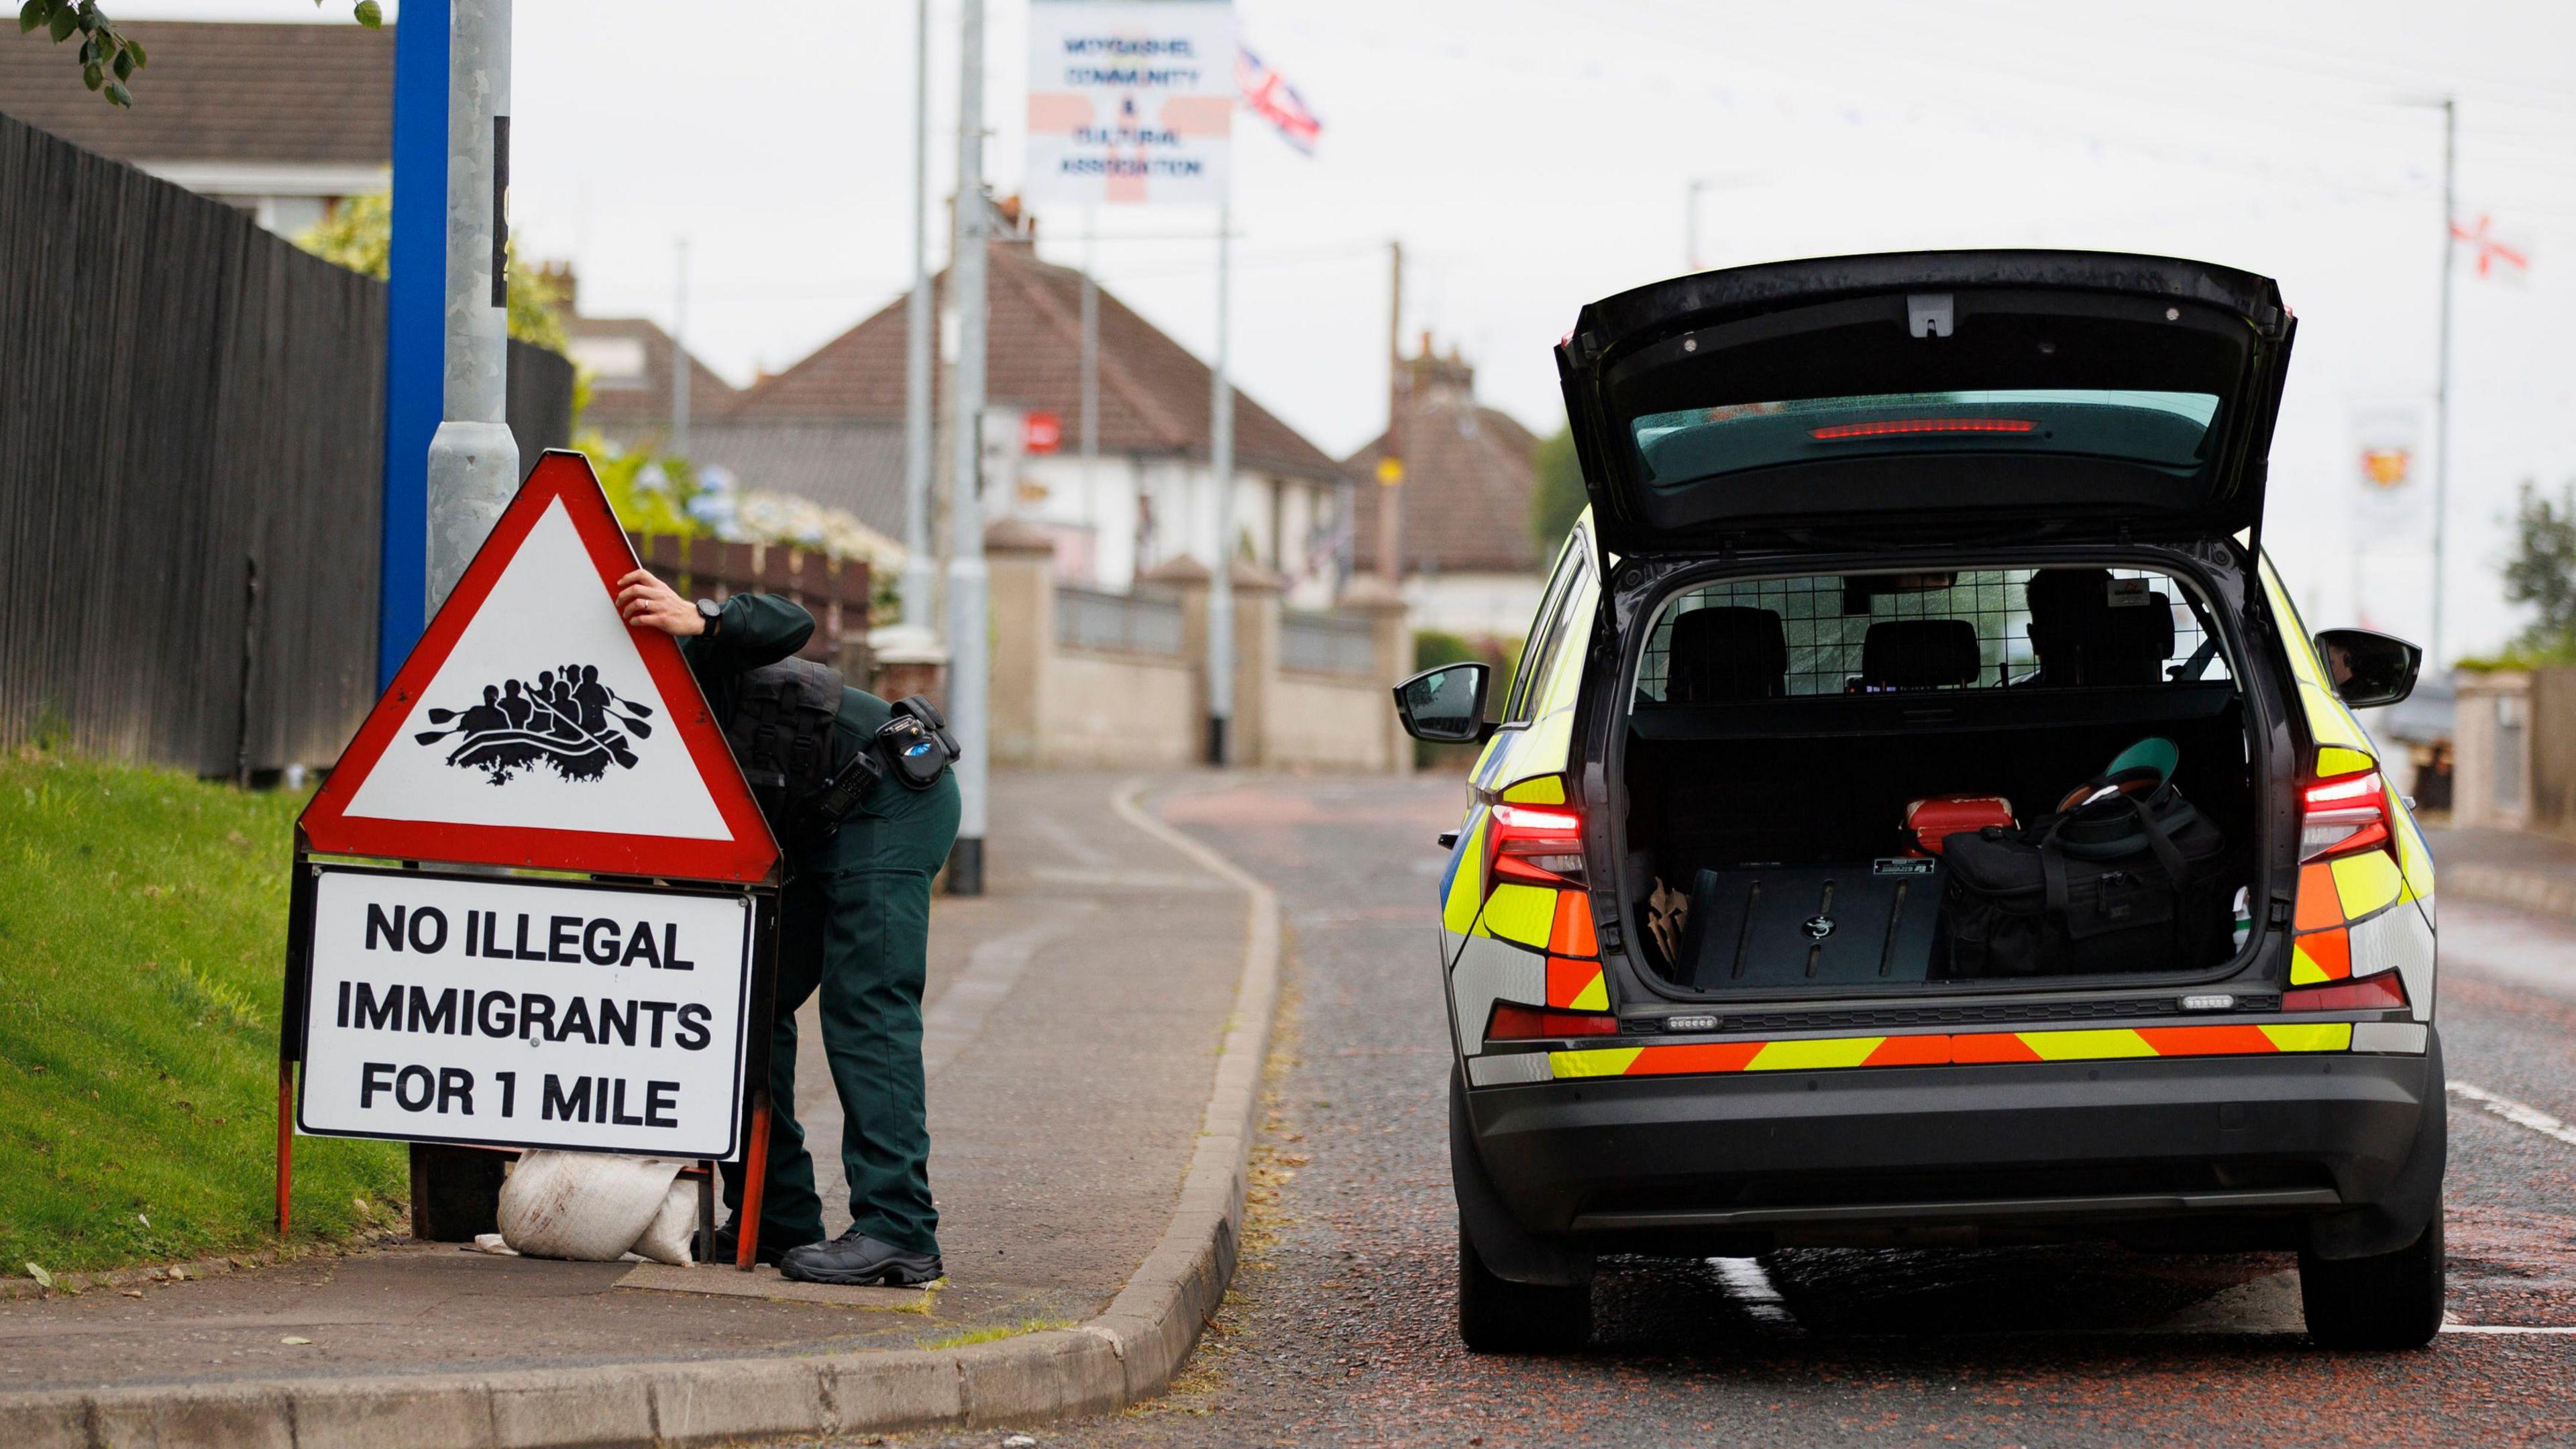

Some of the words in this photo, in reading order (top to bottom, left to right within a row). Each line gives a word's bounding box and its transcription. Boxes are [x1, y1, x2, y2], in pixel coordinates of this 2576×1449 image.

[1065, 67, 1200, 87] COMMUNITY
[1061, 158, 1204, 176] ASSOCIATION
[365, 903, 448, 954] NO
[465, 910, 694, 971] ILLEGAL
[337, 981, 712, 1051] IMMIGRANTS
[360, 1062, 474, 1116] FOR
[495, 1071, 516, 1118] 1
[541, 1073, 680, 1128] MILE
